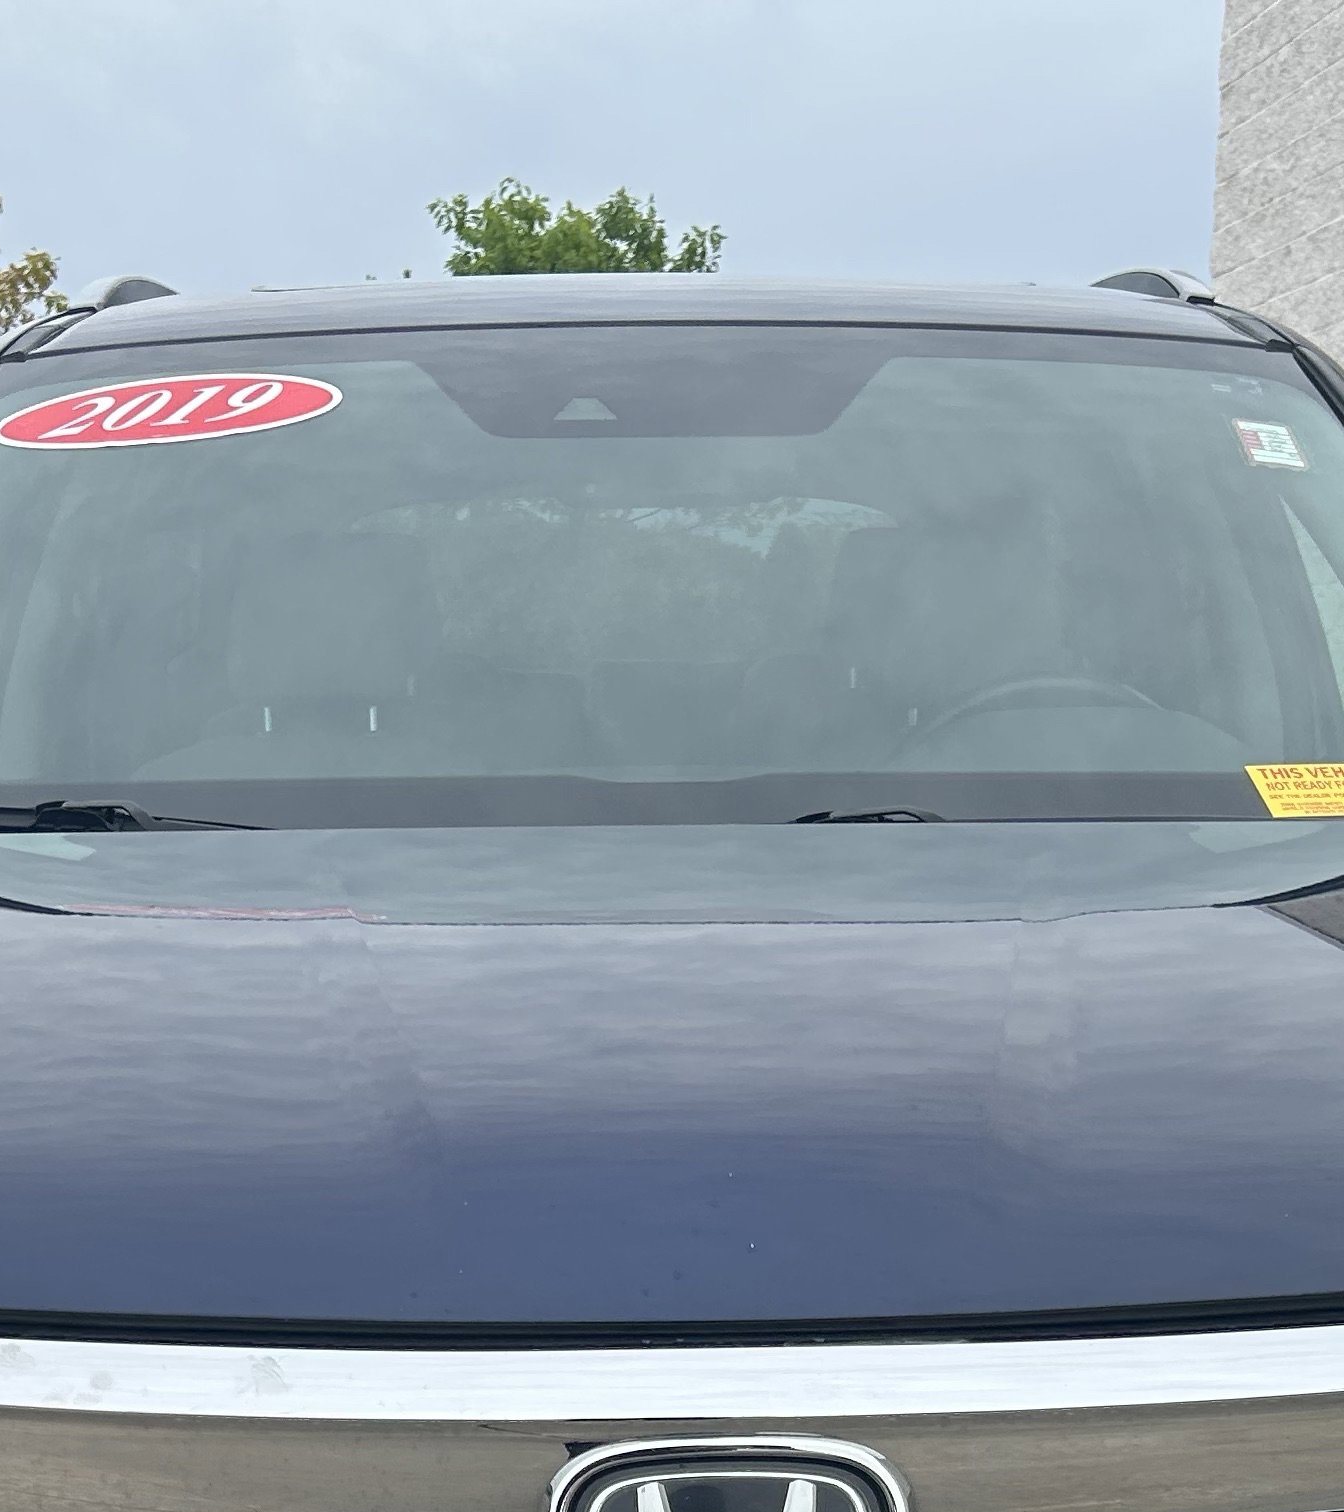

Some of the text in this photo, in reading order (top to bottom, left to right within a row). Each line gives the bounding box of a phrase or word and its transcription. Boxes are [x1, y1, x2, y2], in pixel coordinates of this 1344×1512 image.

[37, 381, 283, 439] 2019
[1256, 768, 1302, 780] THIS
[1266, 782, 1290, 791] NOT
[1293, 781, 1331, 790] READY
